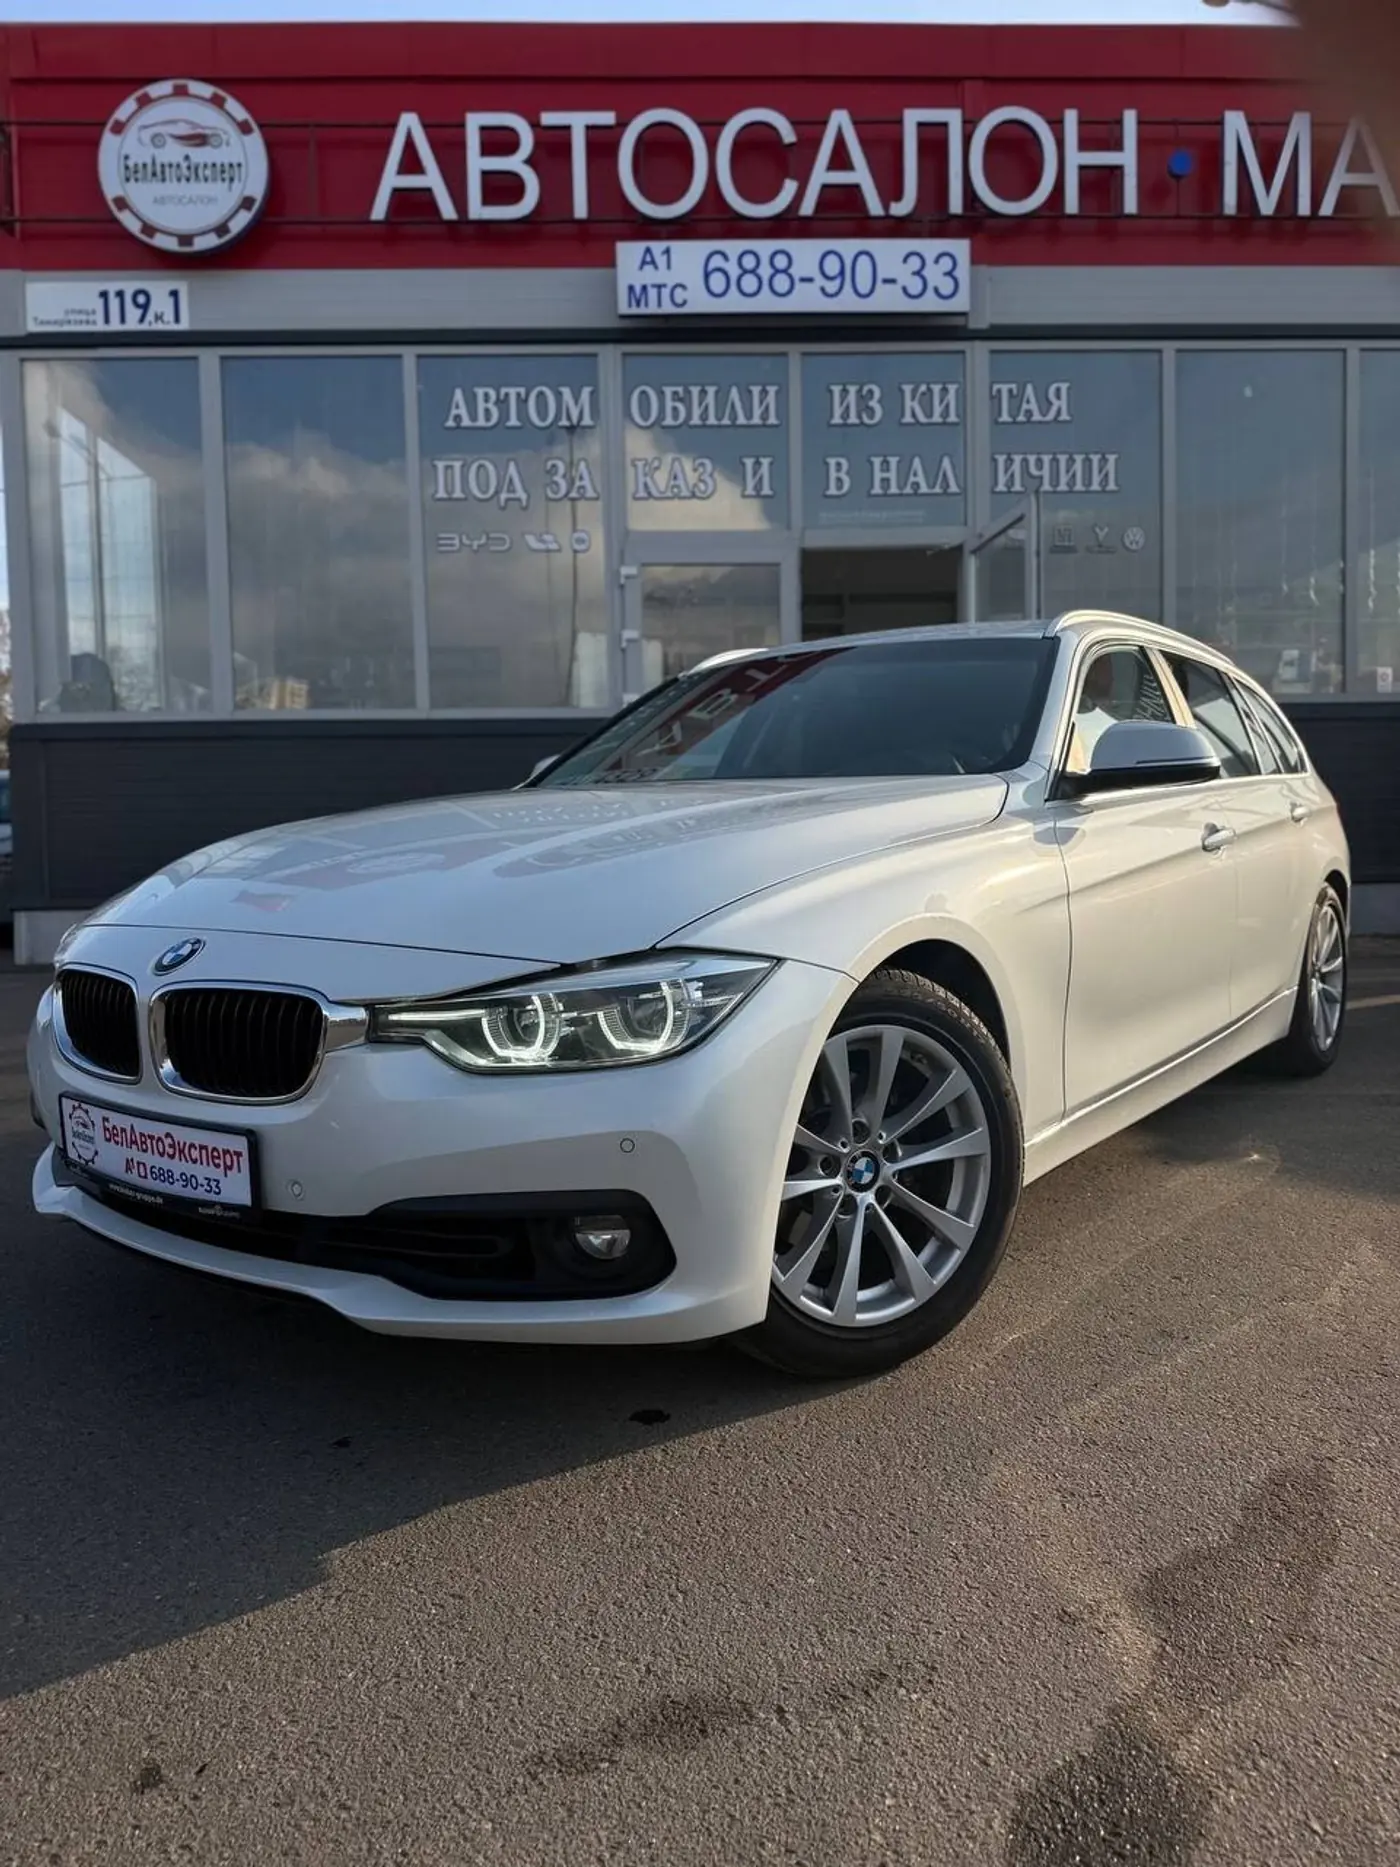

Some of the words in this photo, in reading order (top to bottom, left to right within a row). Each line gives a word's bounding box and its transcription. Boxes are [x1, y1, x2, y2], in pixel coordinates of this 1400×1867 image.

[123, 154, 243, 192] БелАвтоЭксперт
[369, 106, 1139, 220] АВТОСАЛОН
[626, 283, 688, 309] МТС
[703, 248, 960, 300] 688-90-33
[828, 384, 883, 425] ИЗ
[434, 459, 529, 509] ПОД
[742, 457, 774, 497] И
[825, 457, 850, 496] В
[102, 1115, 244, 1177] БелАвтоЭксперт
[150, 1165, 222, 1196] 688-90-33
